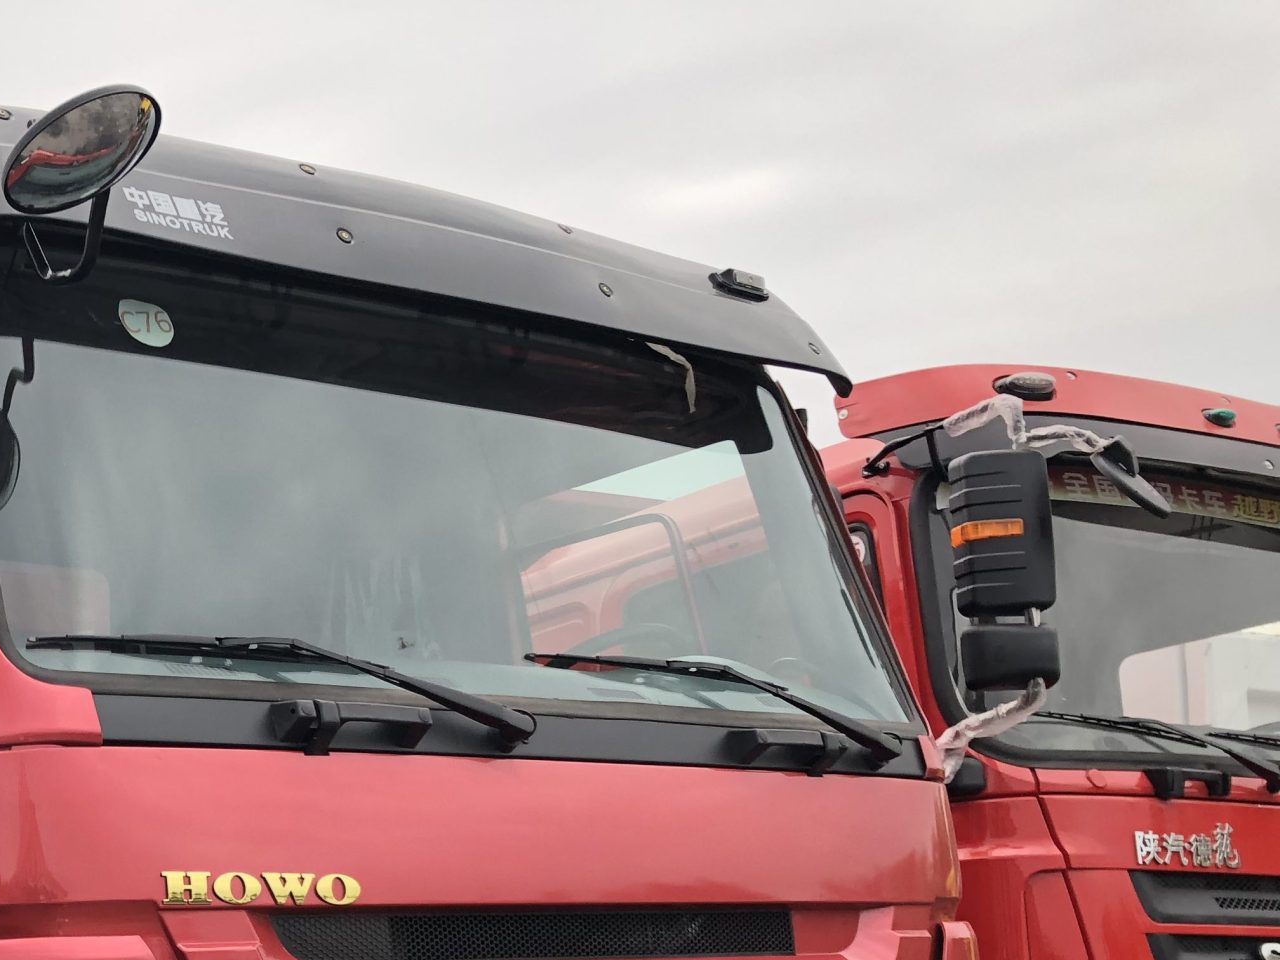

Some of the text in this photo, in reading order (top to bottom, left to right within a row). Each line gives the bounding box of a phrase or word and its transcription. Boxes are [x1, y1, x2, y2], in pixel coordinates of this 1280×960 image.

[133, 208, 235, 241] SINOTRUK
[121, 311, 172, 333] C76
[161, 870, 361, 906] HOWO
